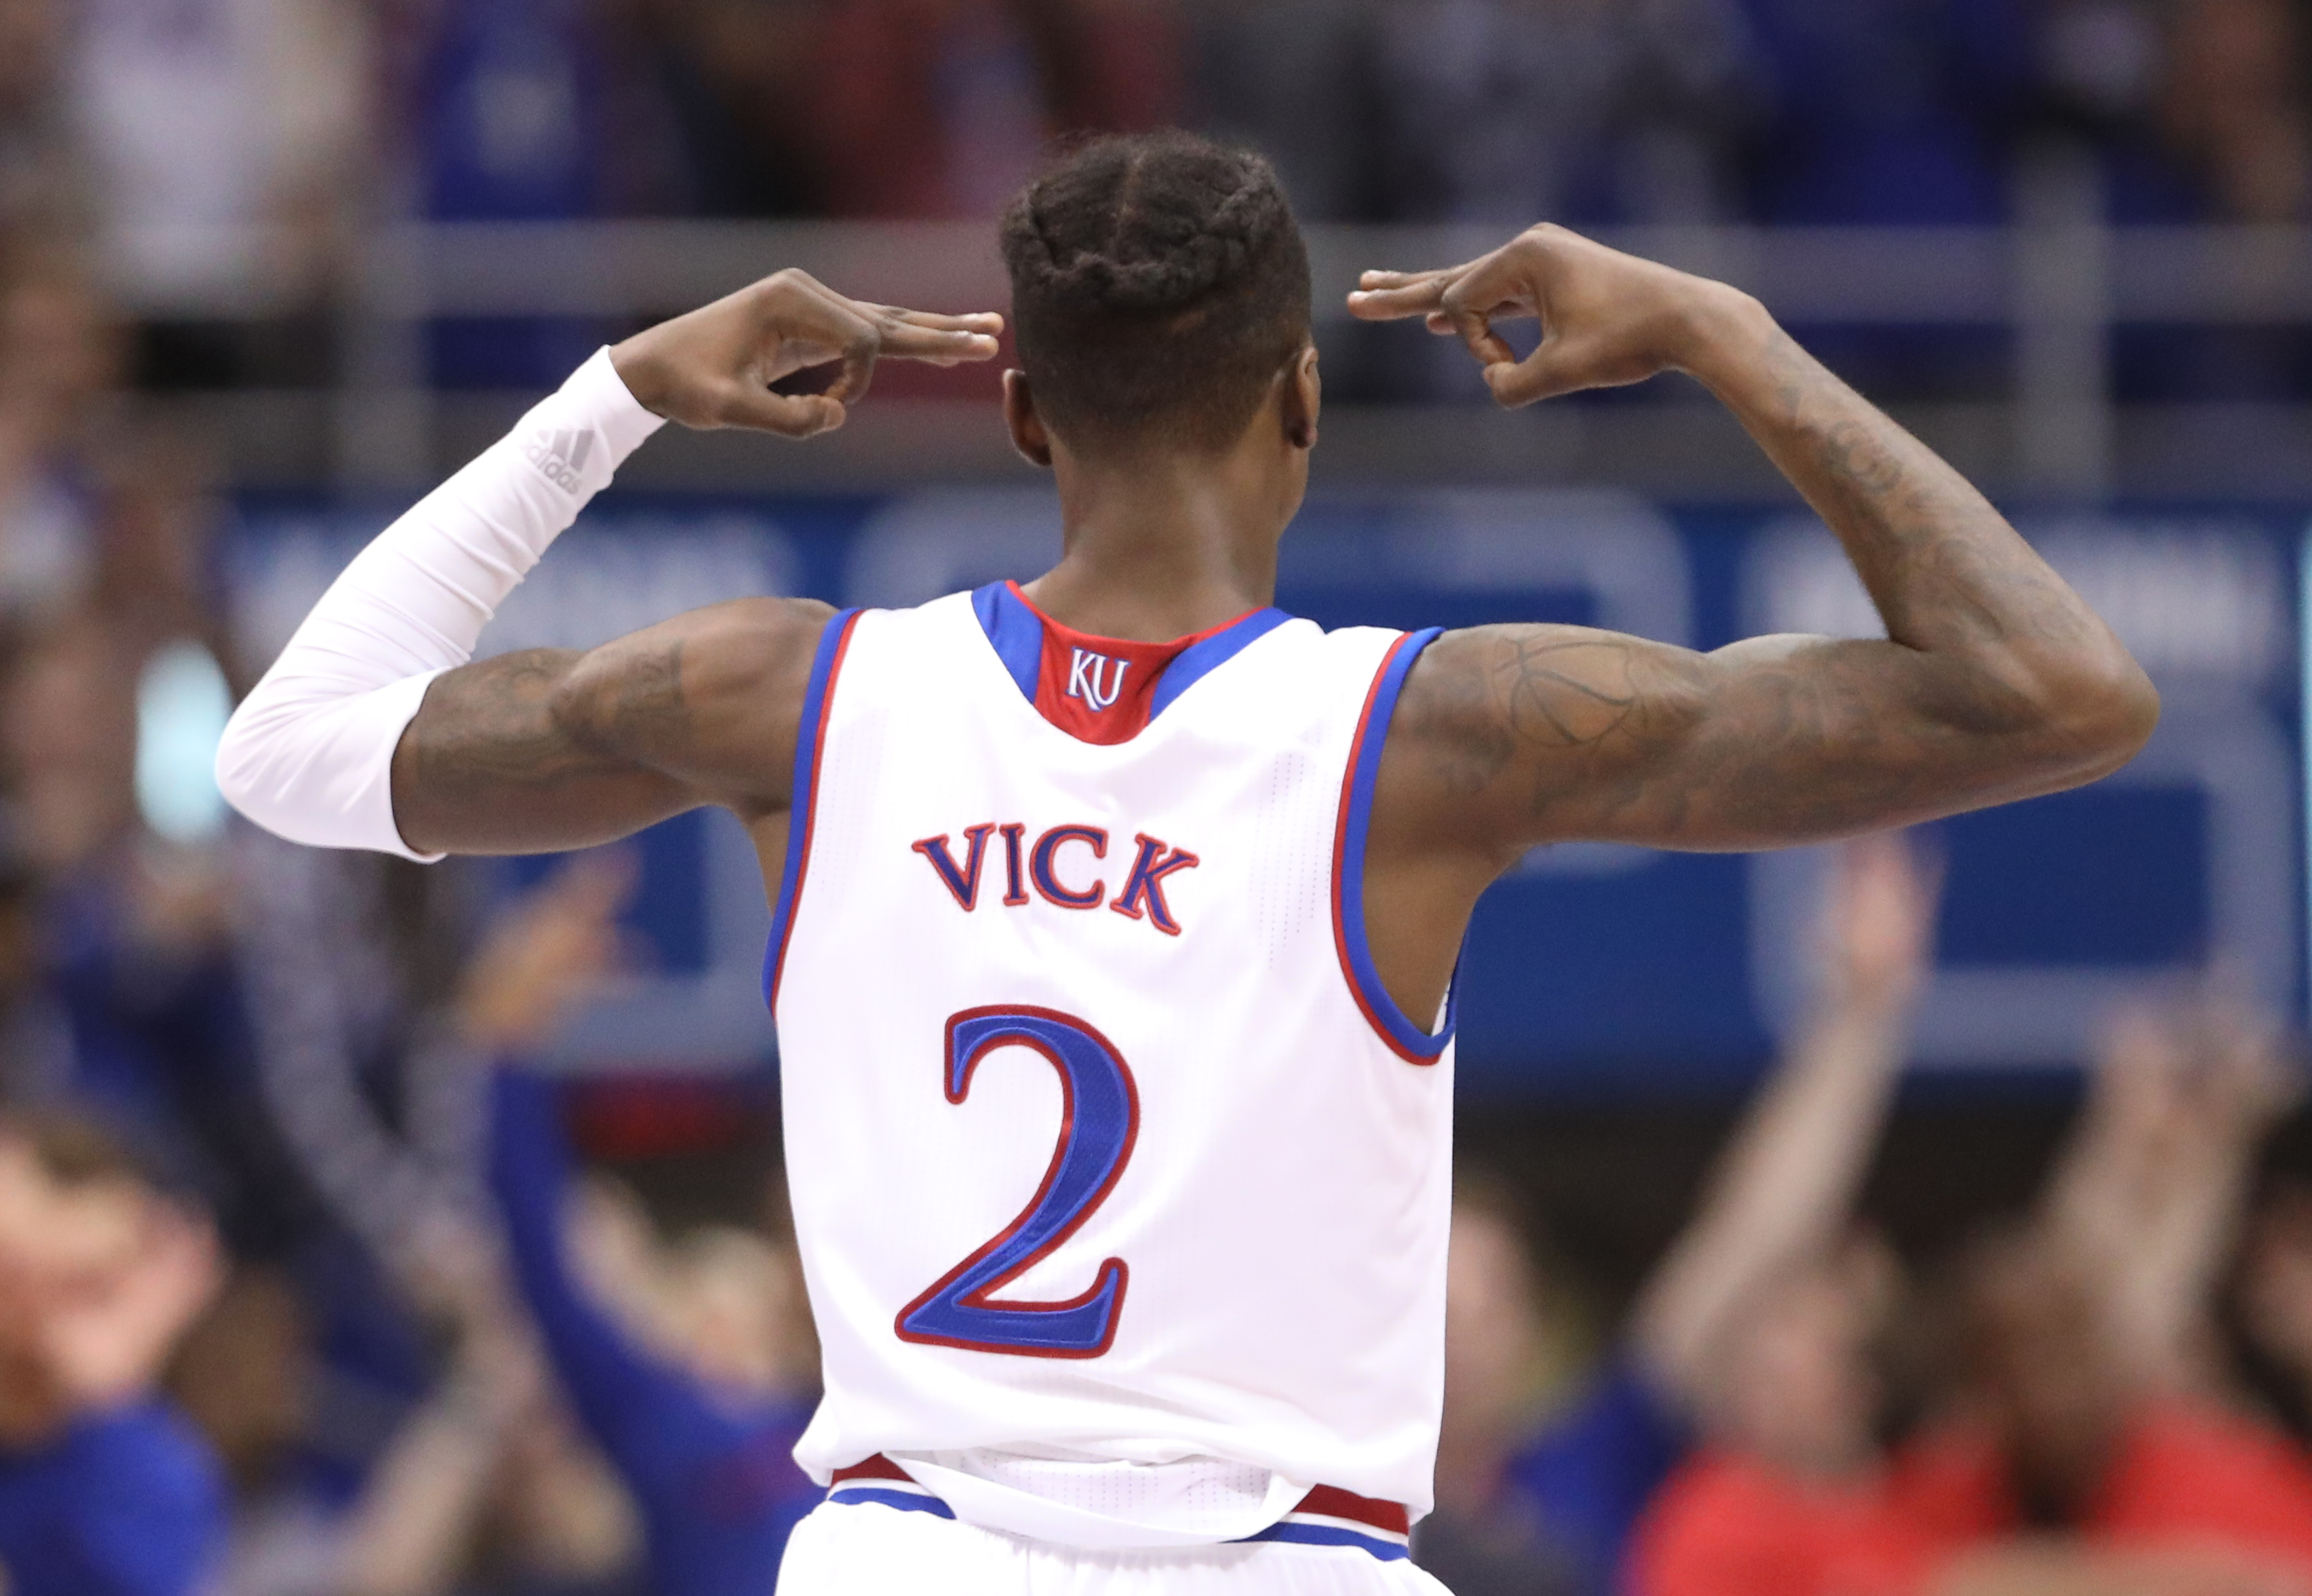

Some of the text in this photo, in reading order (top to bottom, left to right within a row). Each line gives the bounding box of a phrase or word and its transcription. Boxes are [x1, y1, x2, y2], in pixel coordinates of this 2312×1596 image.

[1065, 646, 1131, 712] KU
[912, 822, 1200, 937] VICK
[895, 1004, 1141, 1359] 2
